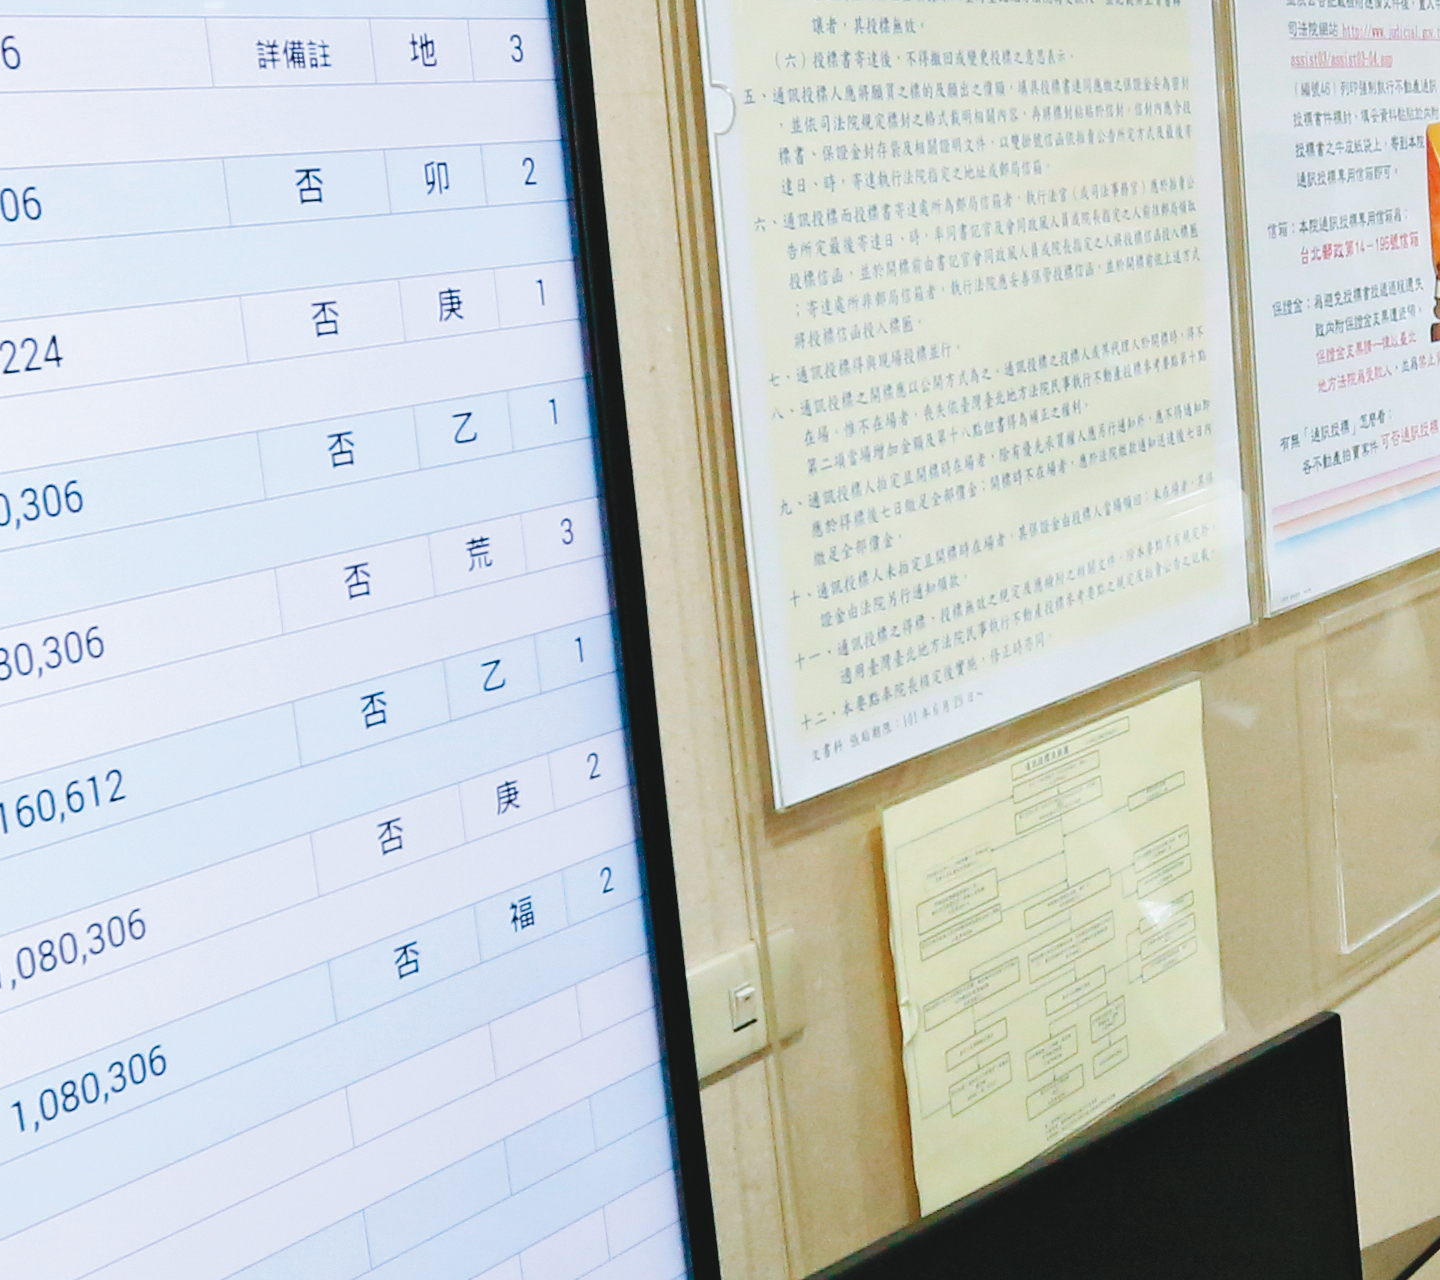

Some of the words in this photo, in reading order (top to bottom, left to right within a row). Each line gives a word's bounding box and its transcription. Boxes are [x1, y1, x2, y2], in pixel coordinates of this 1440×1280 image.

[256, 38, 332, 72] 詳備註
[408, 34, 438, 68] 地
[509, 34, 525, 65] 3
[294, 166, 324, 207] 否
[423, 161, 451, 196] 卯
[522, 157, 538, 187] 2
[311, 300, 340, 340] 否
[436, 285, 464, 325] 庚
[535, 279, 546, 308] 1
[327, 430, 356, 470] 否
[450, 412, 480, 446] 乙
[548, 397, 559, 426] 1
[343, 560, 372, 602] 否
[466, 534, 493, 572] 荒
[559, 517, 574, 548] 3
[361, 690, 388, 731] 否
[480, 657, 507, 694] 乙
[574, 636, 585, 665] 1
[377, 817, 405, 857] 否
[495, 779, 522, 818] 庚
[586, 752, 602, 780] 2
[10, 1045, 169, 1135] 1,080,306
[393, 941, 421, 981] 否
[509, 895, 536, 934] 福
[599, 866, 615, 895] 2
